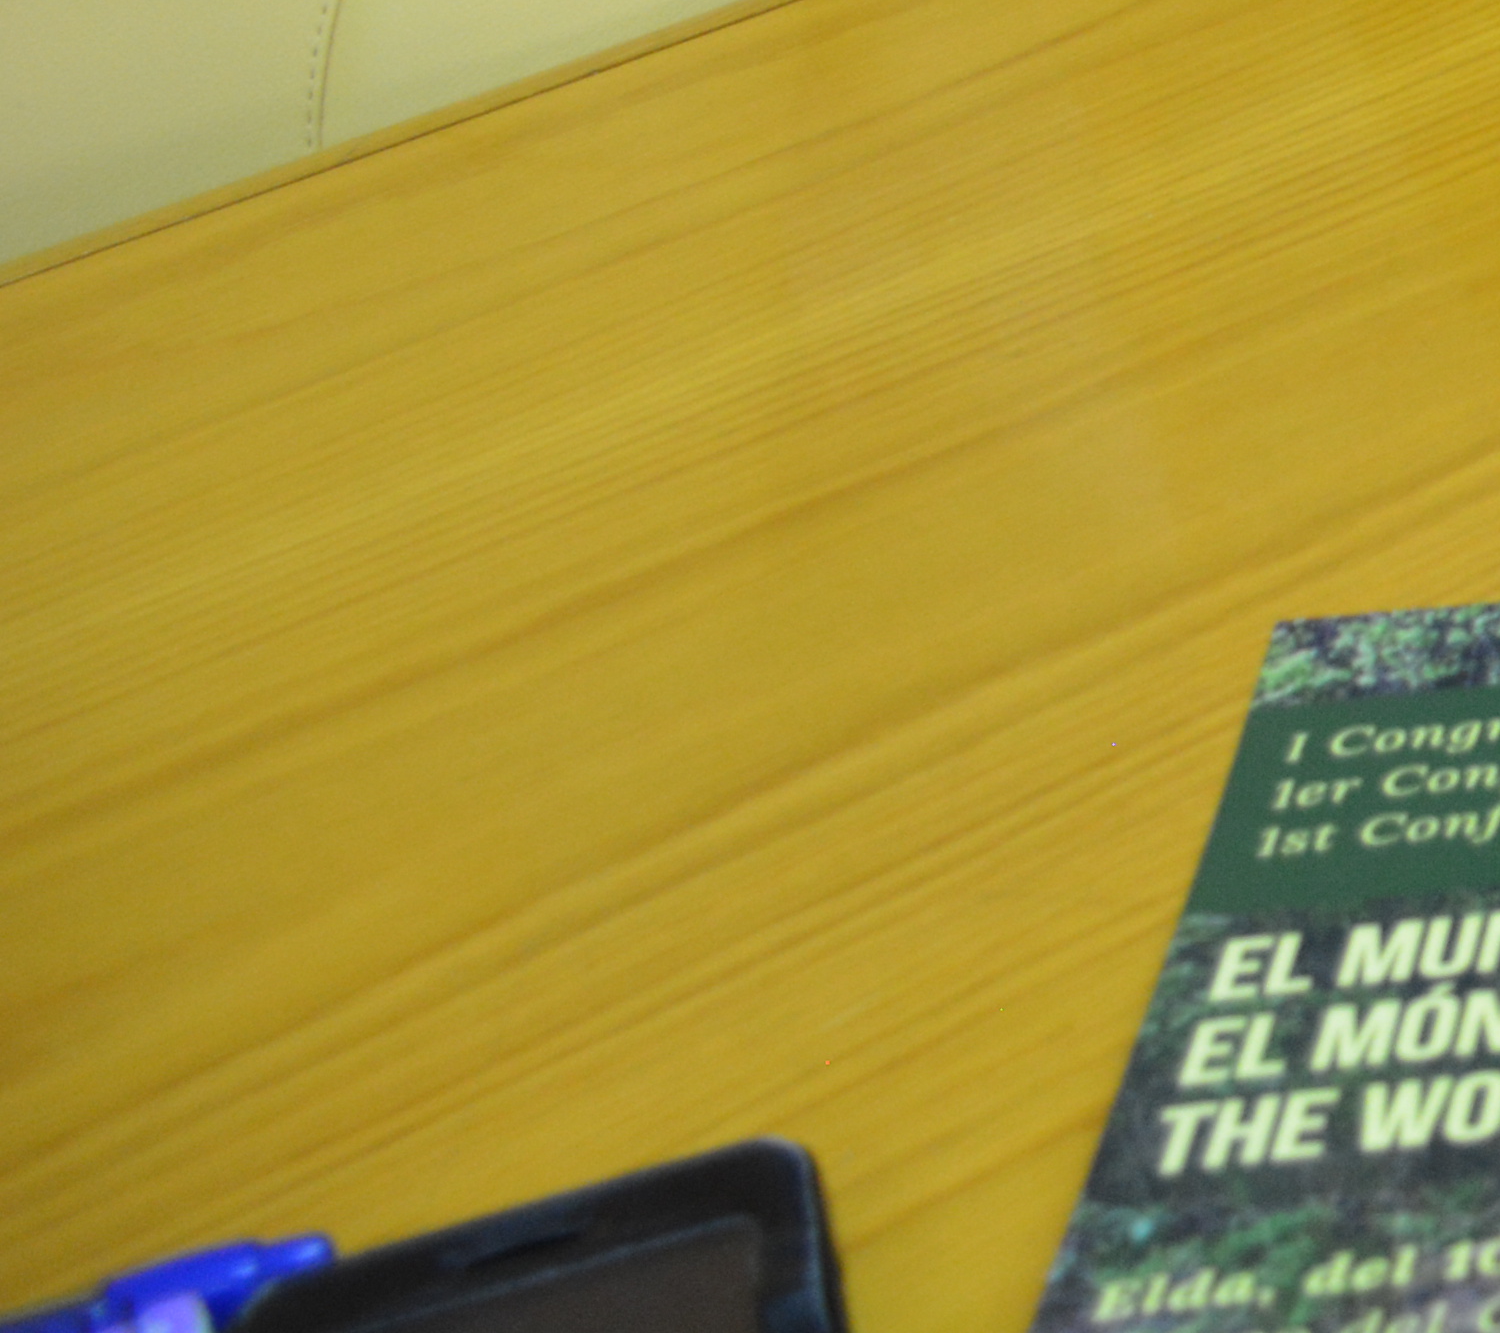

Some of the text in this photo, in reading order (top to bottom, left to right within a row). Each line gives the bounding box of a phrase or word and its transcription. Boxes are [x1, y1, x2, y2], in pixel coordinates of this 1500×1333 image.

[1285, 731, 1306, 763] I
[1270, 777, 1362, 811] 1er
[1254, 824, 1335, 860] 1st
[1208, 931, 1313, 1005] EL
[1178, 1015, 1286, 1091] EL
[1158, 1087, 1339, 1179] THE
[1090, 1270, 1277, 1323] Elda,
[1302, 1244, 1415, 1298] del
